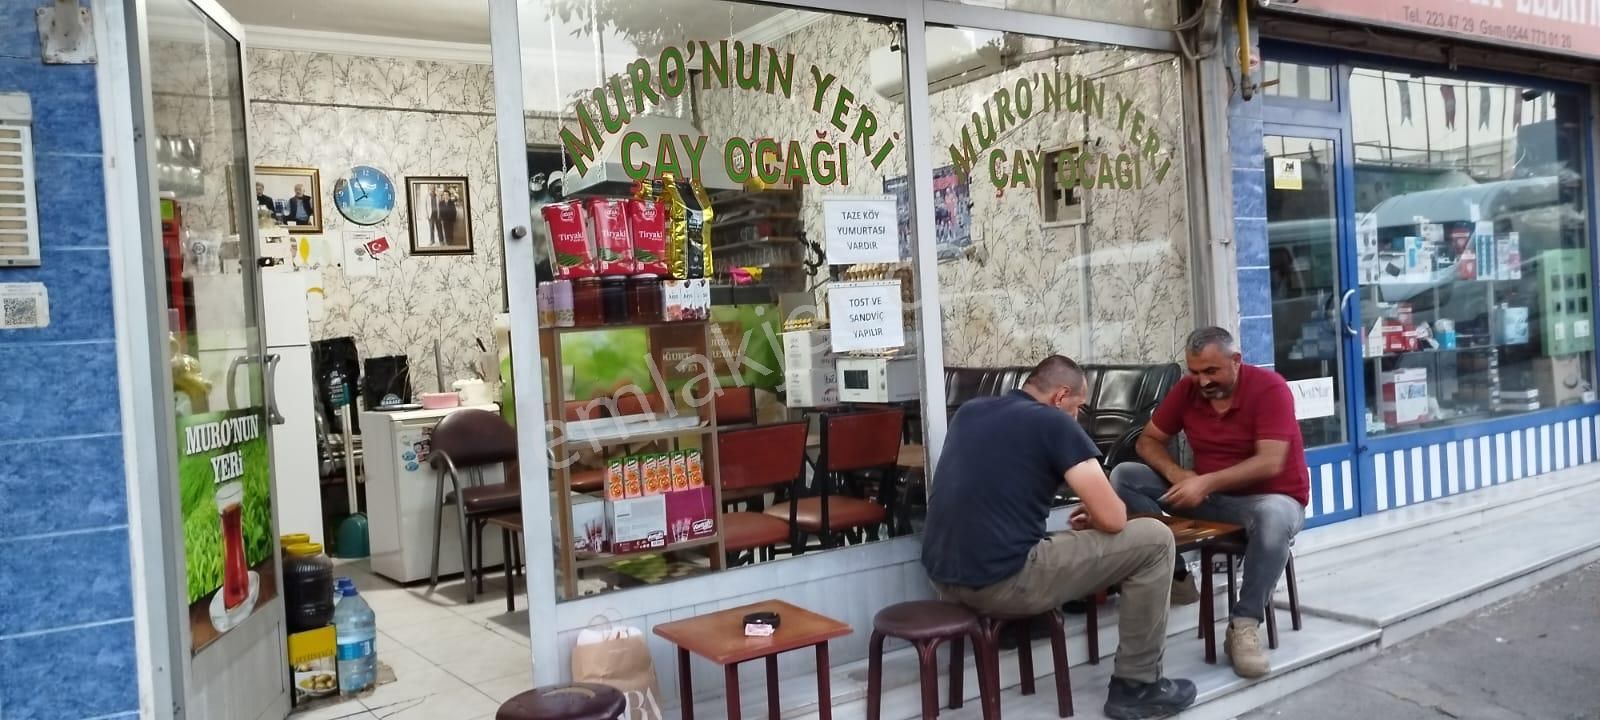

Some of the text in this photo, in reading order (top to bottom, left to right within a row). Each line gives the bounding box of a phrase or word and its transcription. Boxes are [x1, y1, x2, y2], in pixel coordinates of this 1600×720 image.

[1426, 10, 1445, 28] 223
[1448, 14, 1459, 28] 47
[1462, 16, 1475, 33] 29
[559, 39, 901, 178] MURO'NUN YERİ
[949, 72, 1105, 183] MURO'NUN
[621, 129, 849, 193] ÇAY OCAĞI
[988, 143, 1142, 198] ÇAY OCAĞI
[842, 210, 880, 220] TAZE KÖY
[602, 231, 626, 240] Tiryaki
[639, 231, 663, 240] Tiryaki
[837, 226, 886, 236] YUMURTASI
[847, 241, 878, 250] VARDIR
[849, 297, 882, 307] TOST VE
[849, 311, 884, 323] SANDVİÇ
[853, 327, 883, 339] YAPILIR
[185, 414, 259, 456] MURO'NUN
